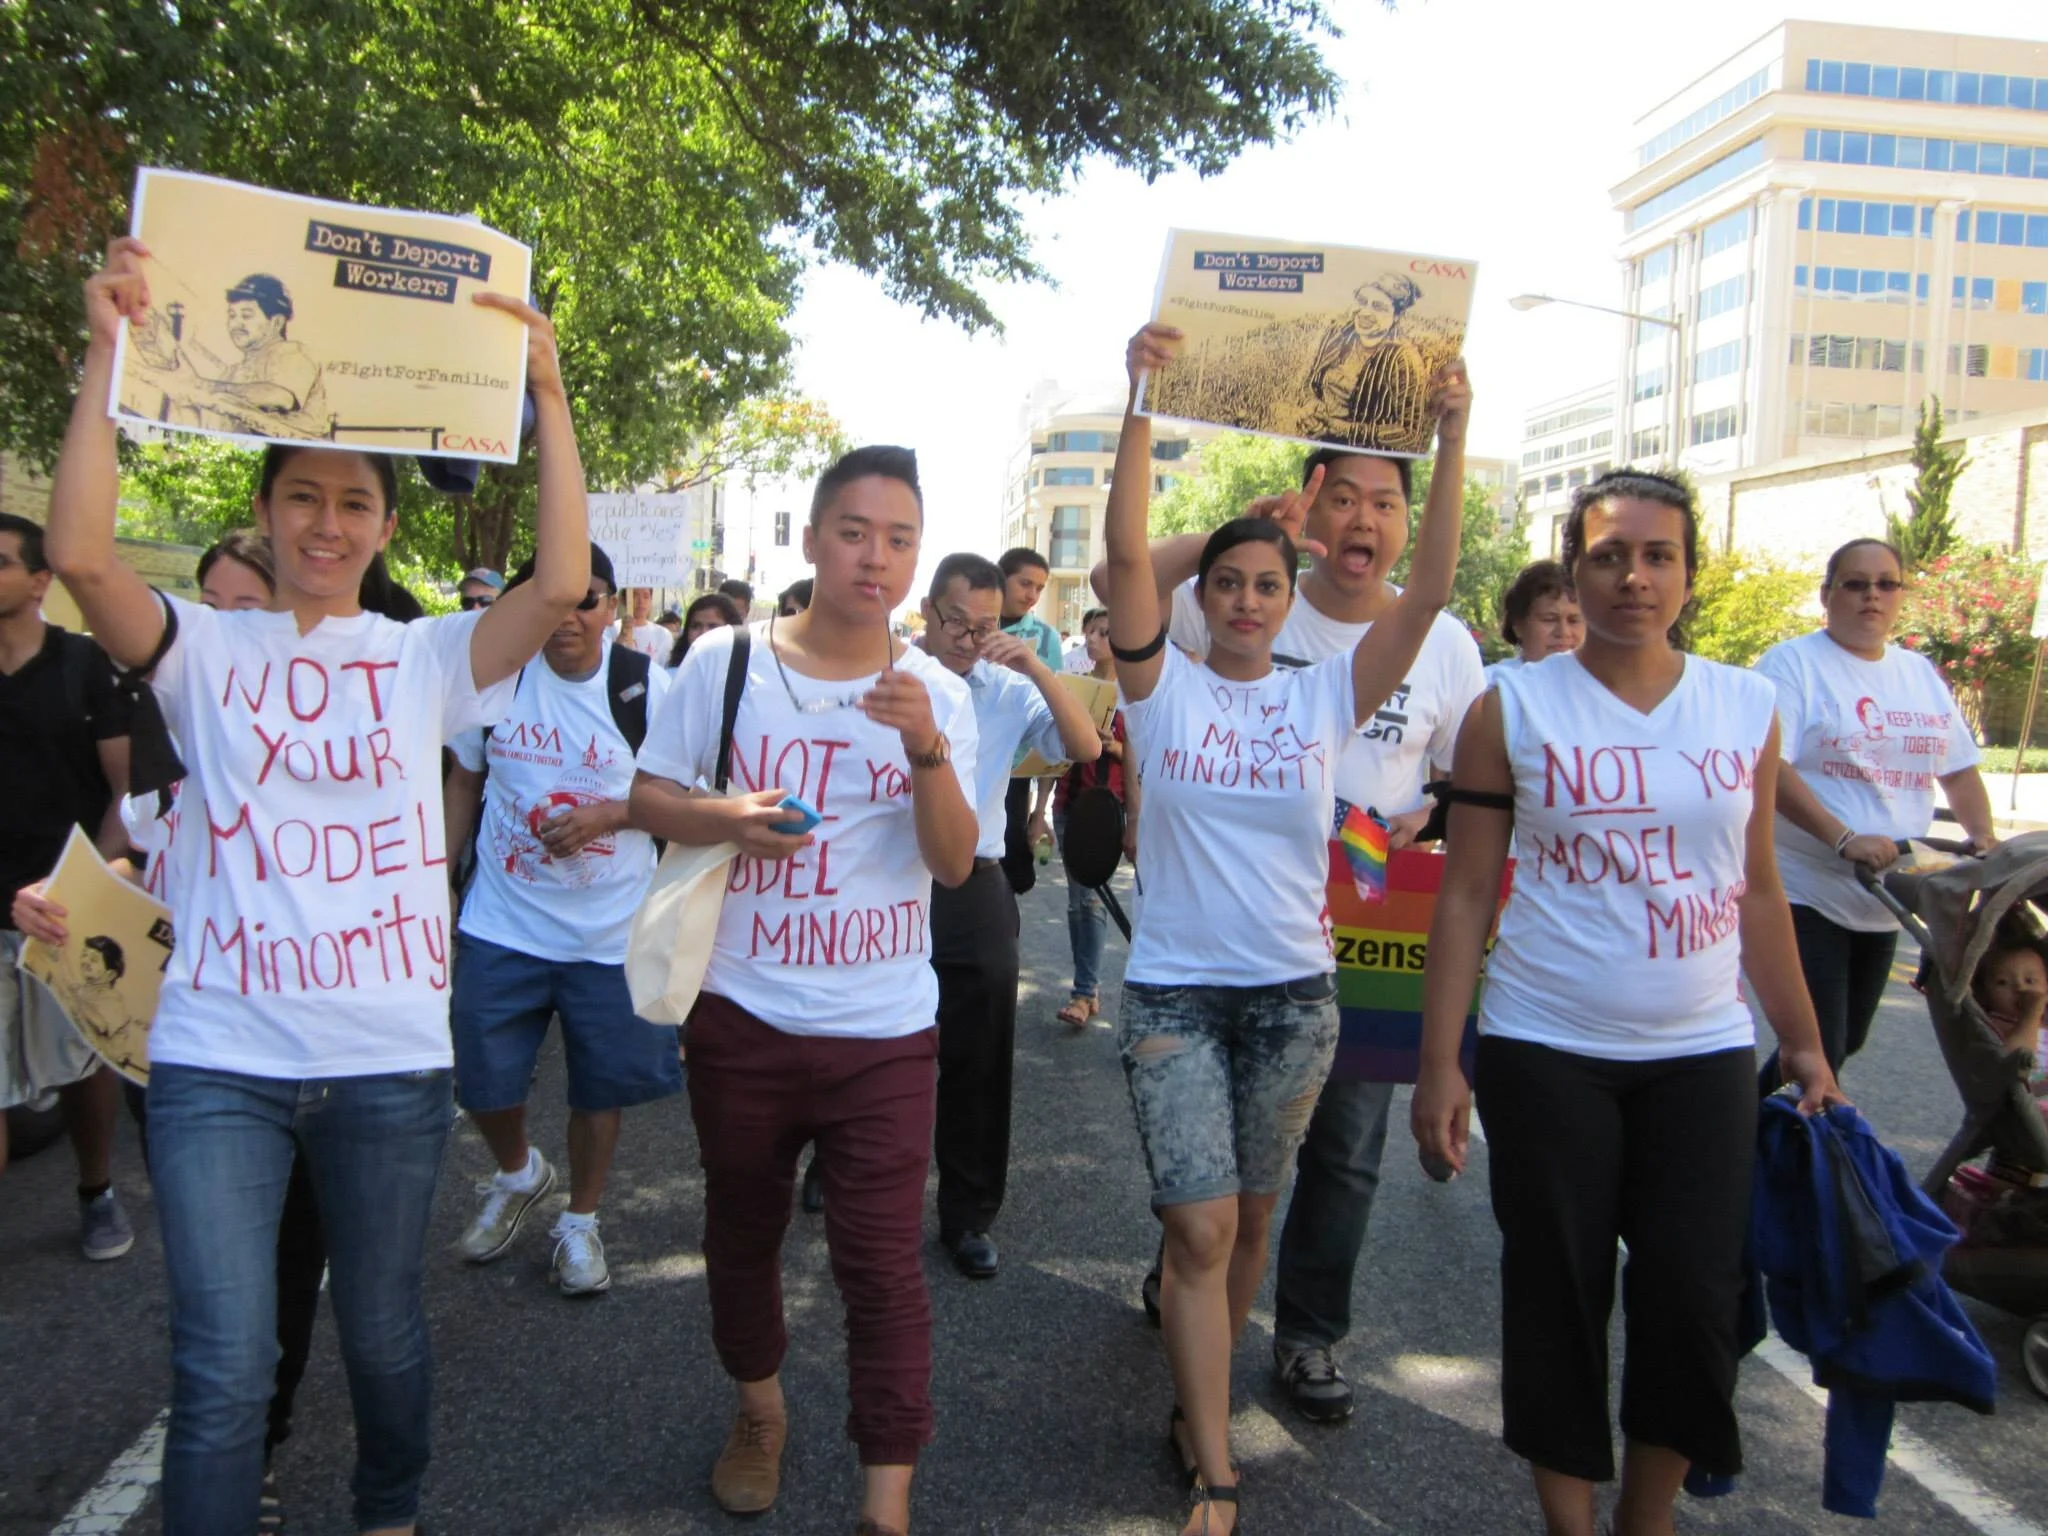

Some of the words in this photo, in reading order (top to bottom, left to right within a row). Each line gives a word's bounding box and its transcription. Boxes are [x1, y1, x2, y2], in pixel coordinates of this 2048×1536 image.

[313, 226, 382, 256] Don't
[390, 239, 480, 272] Deport
[1203, 252, 1250, 268] Don't
[1257, 254, 1320, 270] Deport
[1409, 259, 1467, 280] CASA
[347, 263, 448, 296] Workers
[1224, 272, 1298, 289] Workers
[326, 361, 510, 390] #FightForFamilies
[442, 434, 507, 455] CASA
[222, 657, 399, 722] NOT
[491, 718, 563, 752] CASA
[728, 735, 851, 821] NOT
[1542, 742, 1660, 809] NOT
[207, 800, 447, 882] MODEL
[1533, 825, 1693, 886] MODEL
[729, 840, 838, 899] ODEL
[193, 894, 448, 995] Minority
[747, 900, 927, 966] MINORITY
